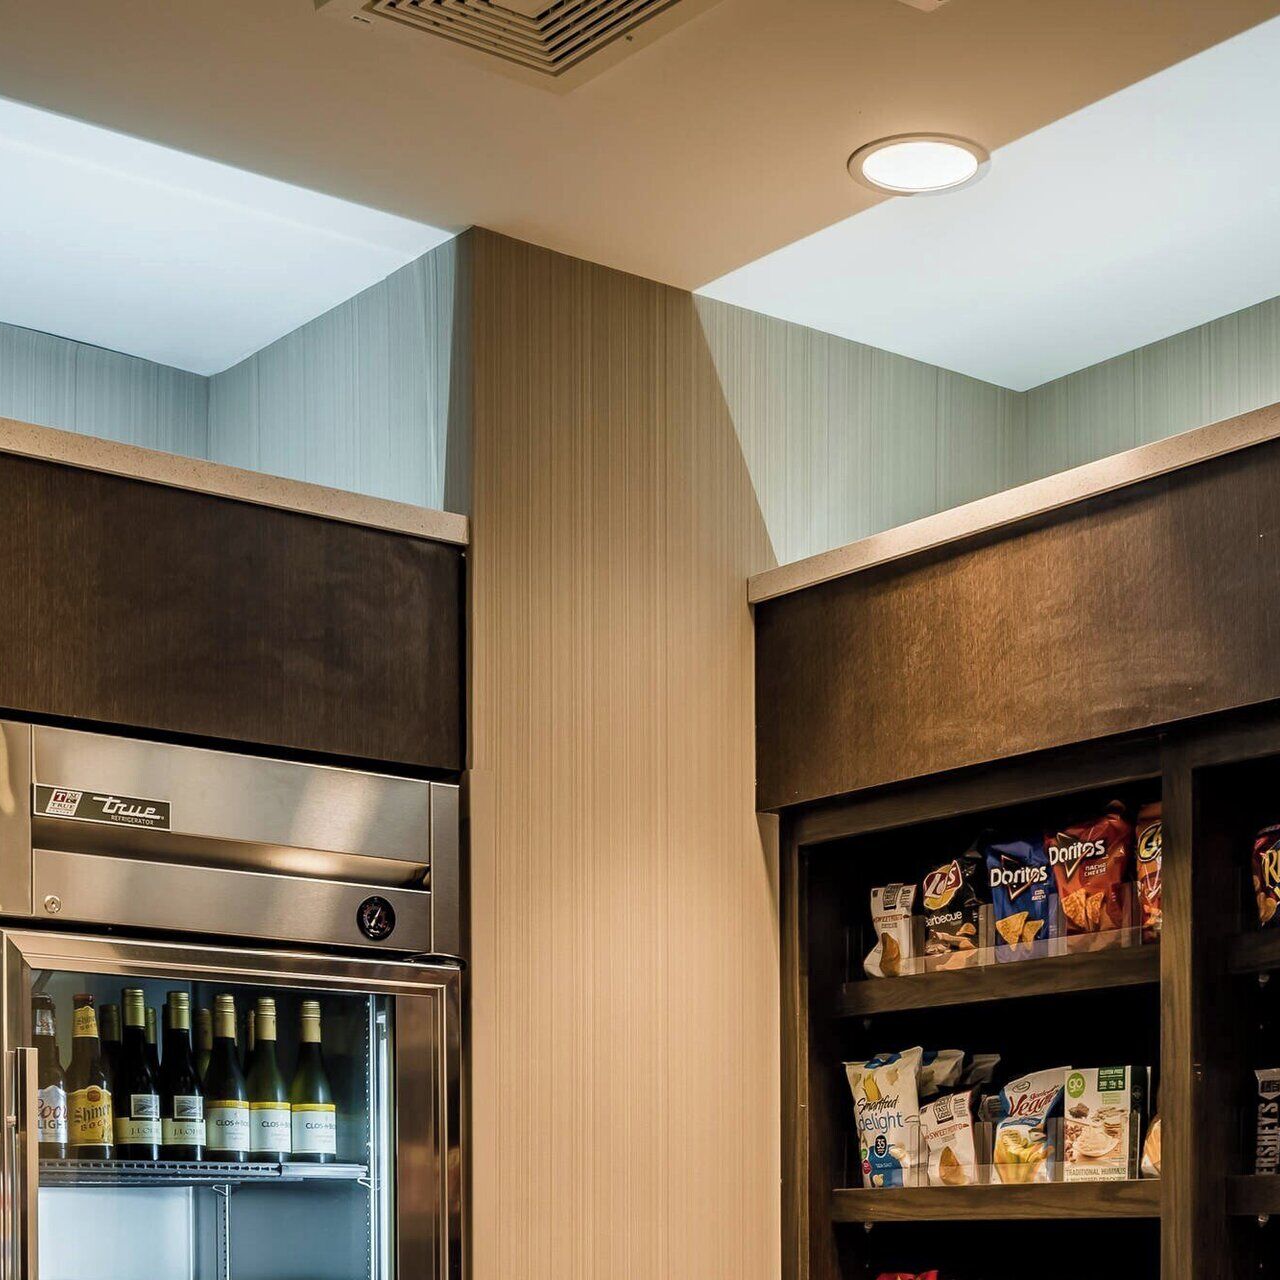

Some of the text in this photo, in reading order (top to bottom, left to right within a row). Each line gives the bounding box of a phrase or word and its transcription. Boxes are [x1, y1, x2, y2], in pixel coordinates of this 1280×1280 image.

[111, 815, 154, 826] REFRIGERATOR
[1049, 840, 1106, 866] Doritos
[990, 865, 1048, 887] Doritos
[1068, 1079, 1082, 1092] go
[859, 1111, 903, 1134] delight
